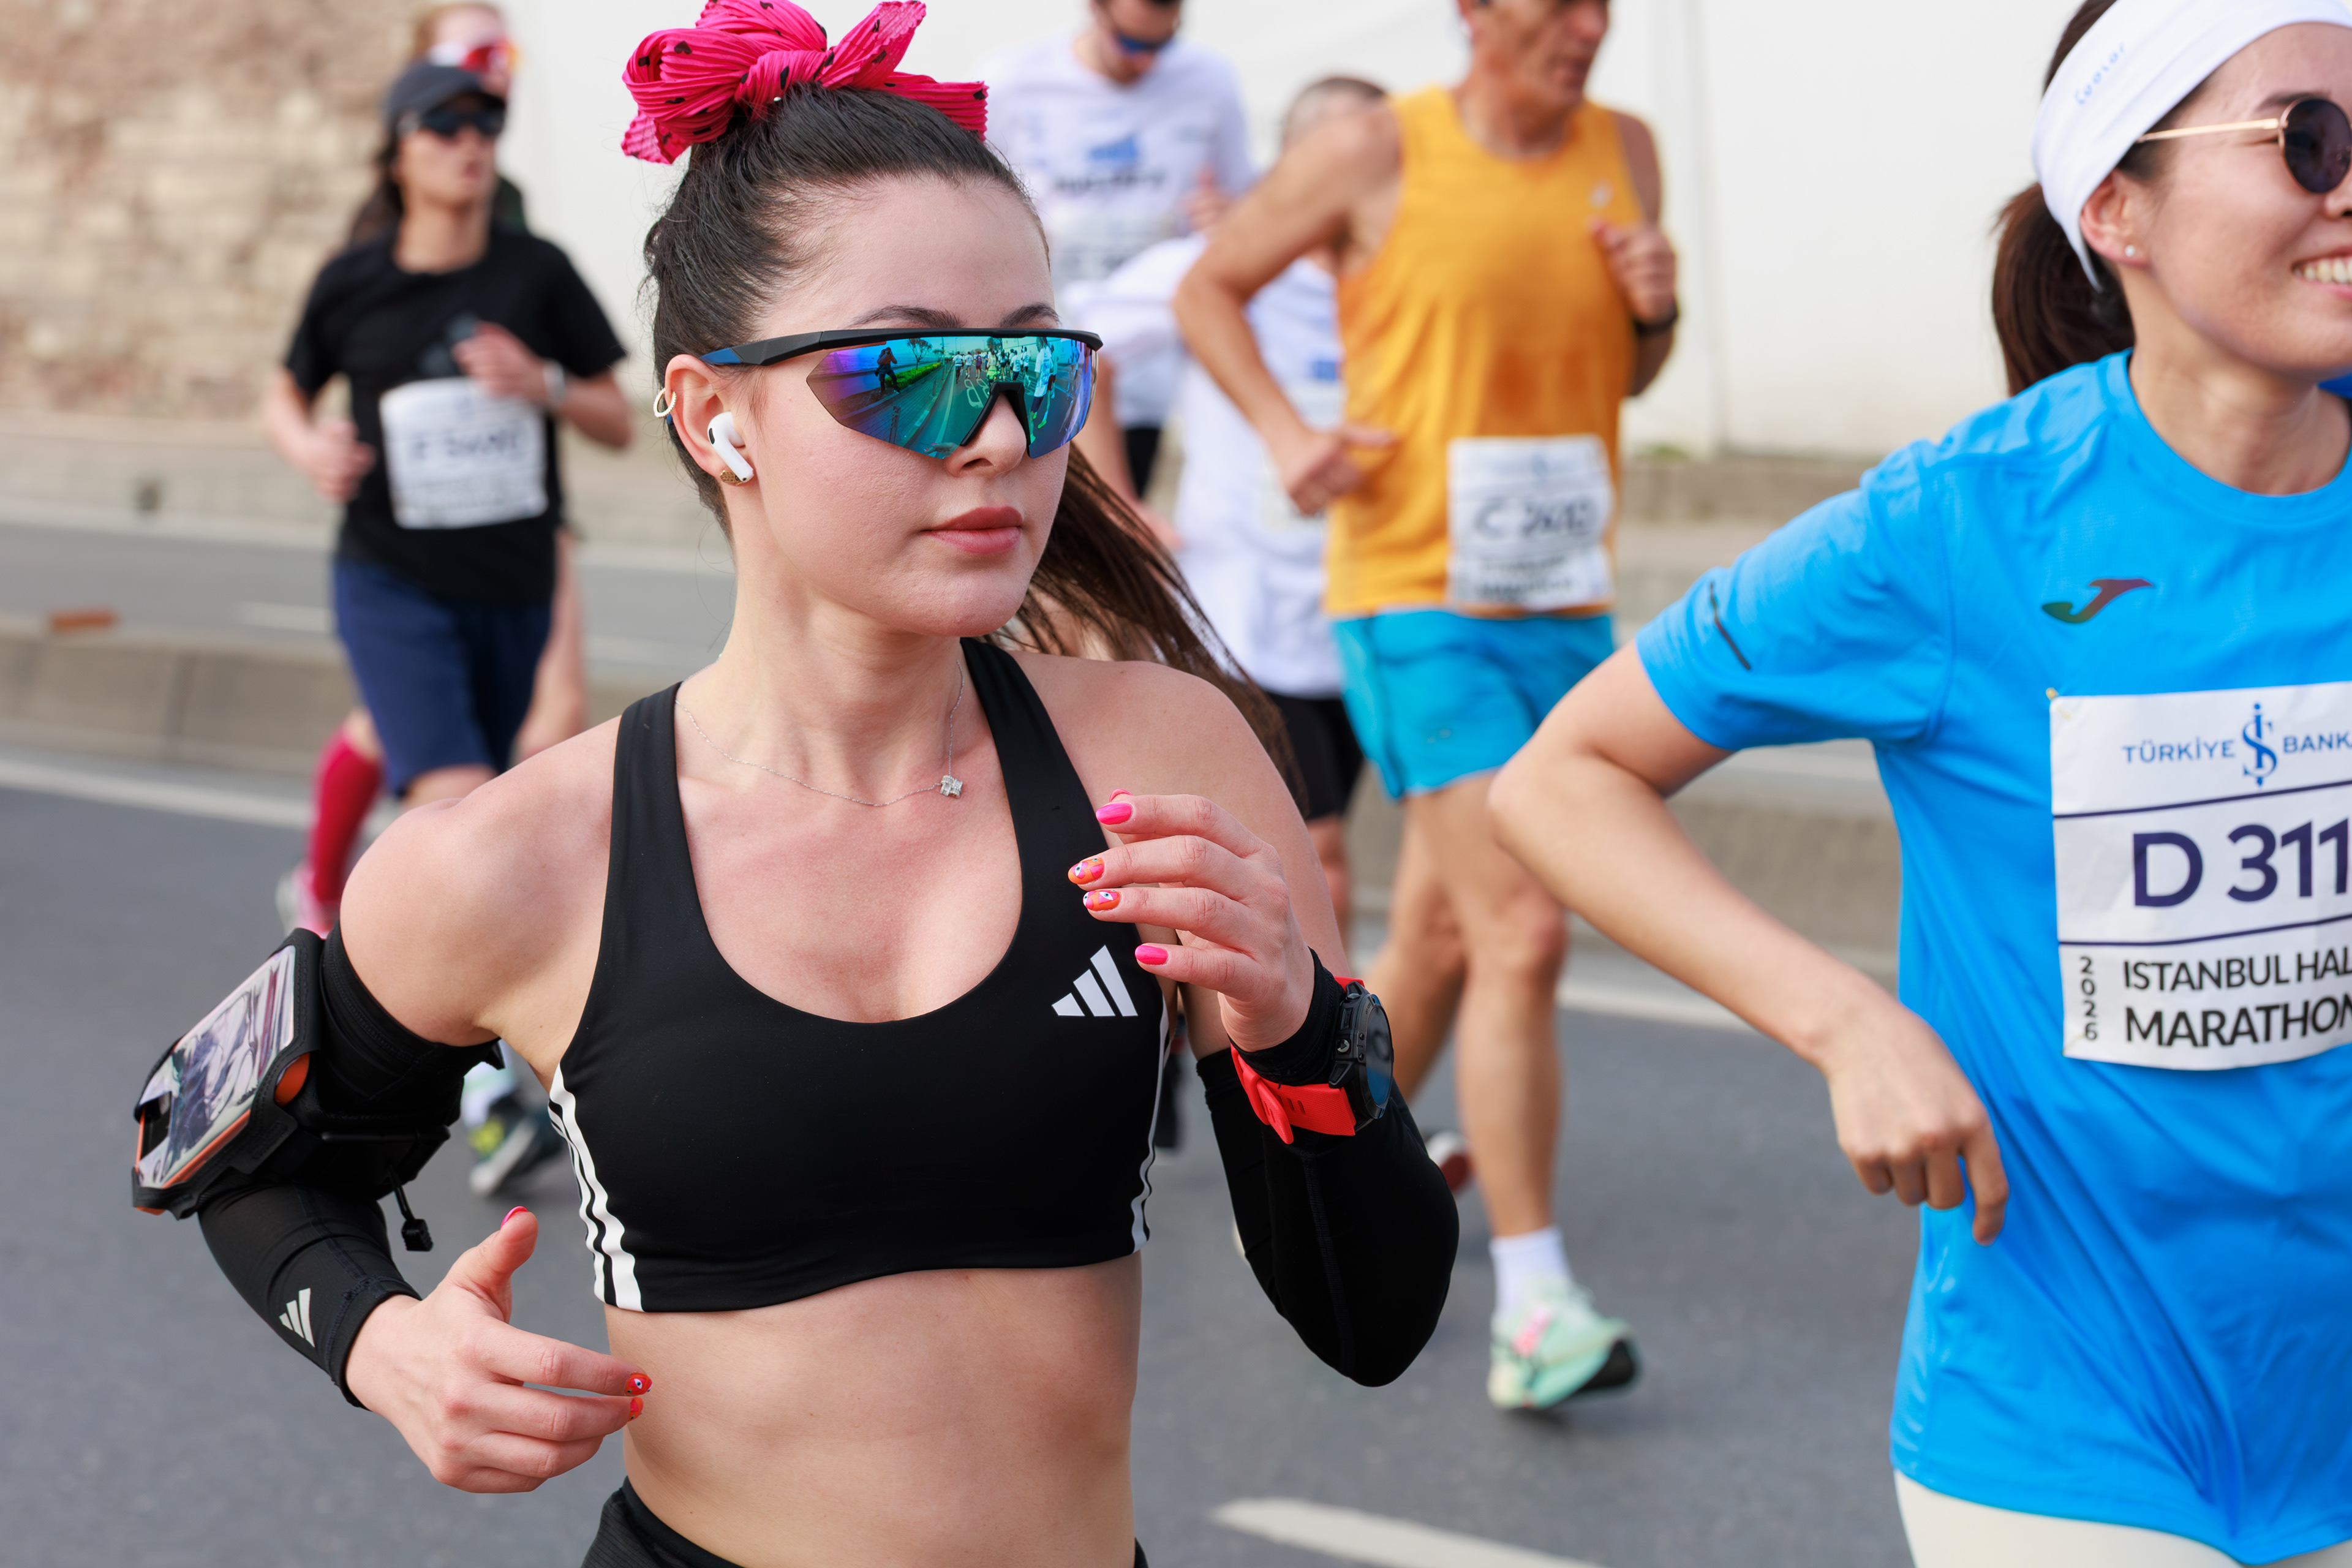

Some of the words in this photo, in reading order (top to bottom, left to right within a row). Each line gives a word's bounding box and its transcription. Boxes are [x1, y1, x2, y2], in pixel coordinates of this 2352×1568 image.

[2122, 737, 2235, 763] TÜRKİYE
[2283, 732, 2352, 753] BANK
[2133, 832, 2203, 908] D
[2228, 818, 2349, 902] 311
[2080, 956, 2098, 1041] 2026
[2124, 954, 2290, 992] ISTANBUL
